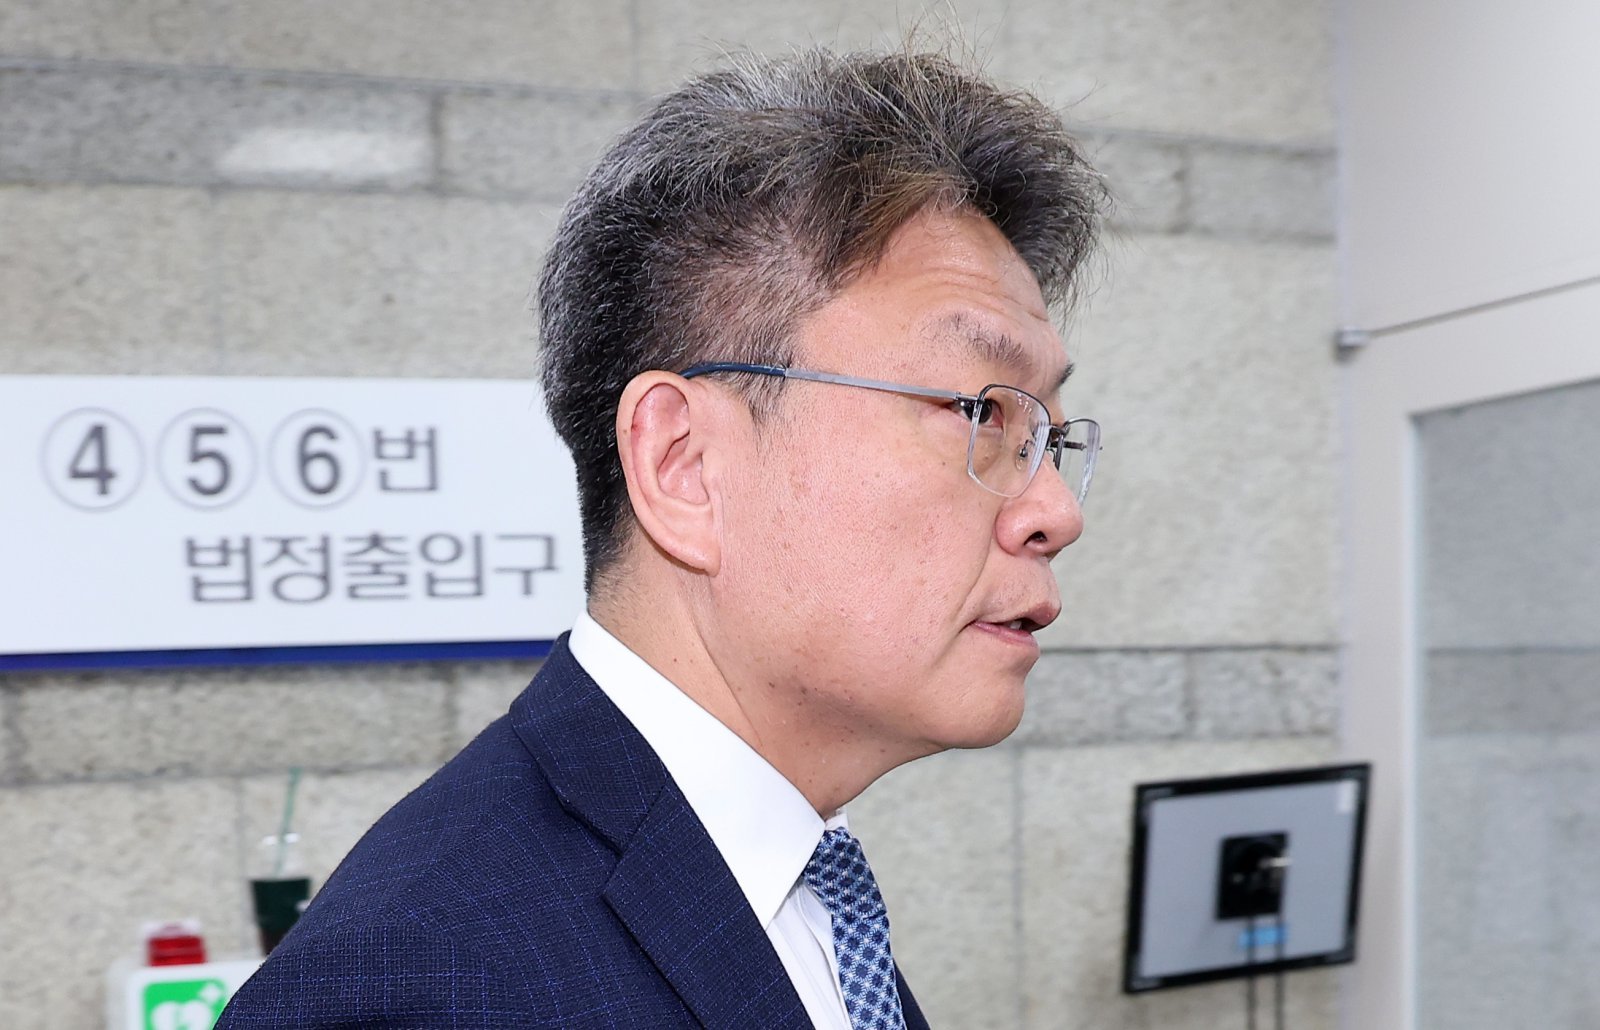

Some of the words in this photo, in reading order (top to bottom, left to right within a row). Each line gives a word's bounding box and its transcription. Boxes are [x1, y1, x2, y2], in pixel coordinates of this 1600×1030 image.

[68, 423, 118, 497] 4
[187, 424, 233, 497] 5
[185, 531, 558, 603] 법정출입구
